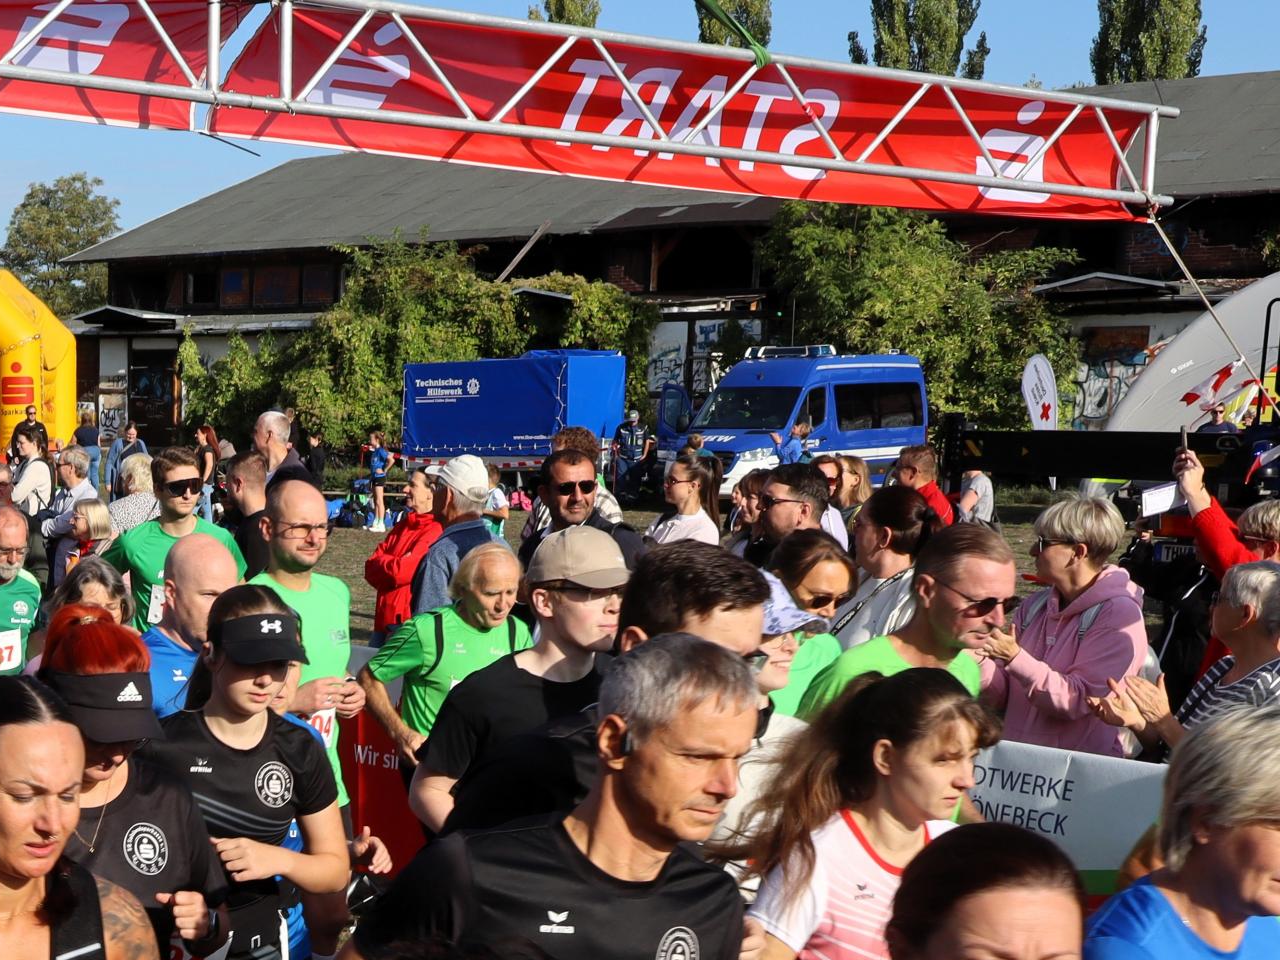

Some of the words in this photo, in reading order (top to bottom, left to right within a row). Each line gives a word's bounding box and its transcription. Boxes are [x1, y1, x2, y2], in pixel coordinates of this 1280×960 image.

[415, 378, 463, 388] Technisches
[427, 387, 463, 397] Hilfswerk
[354, 743, 379, 766] Wir
